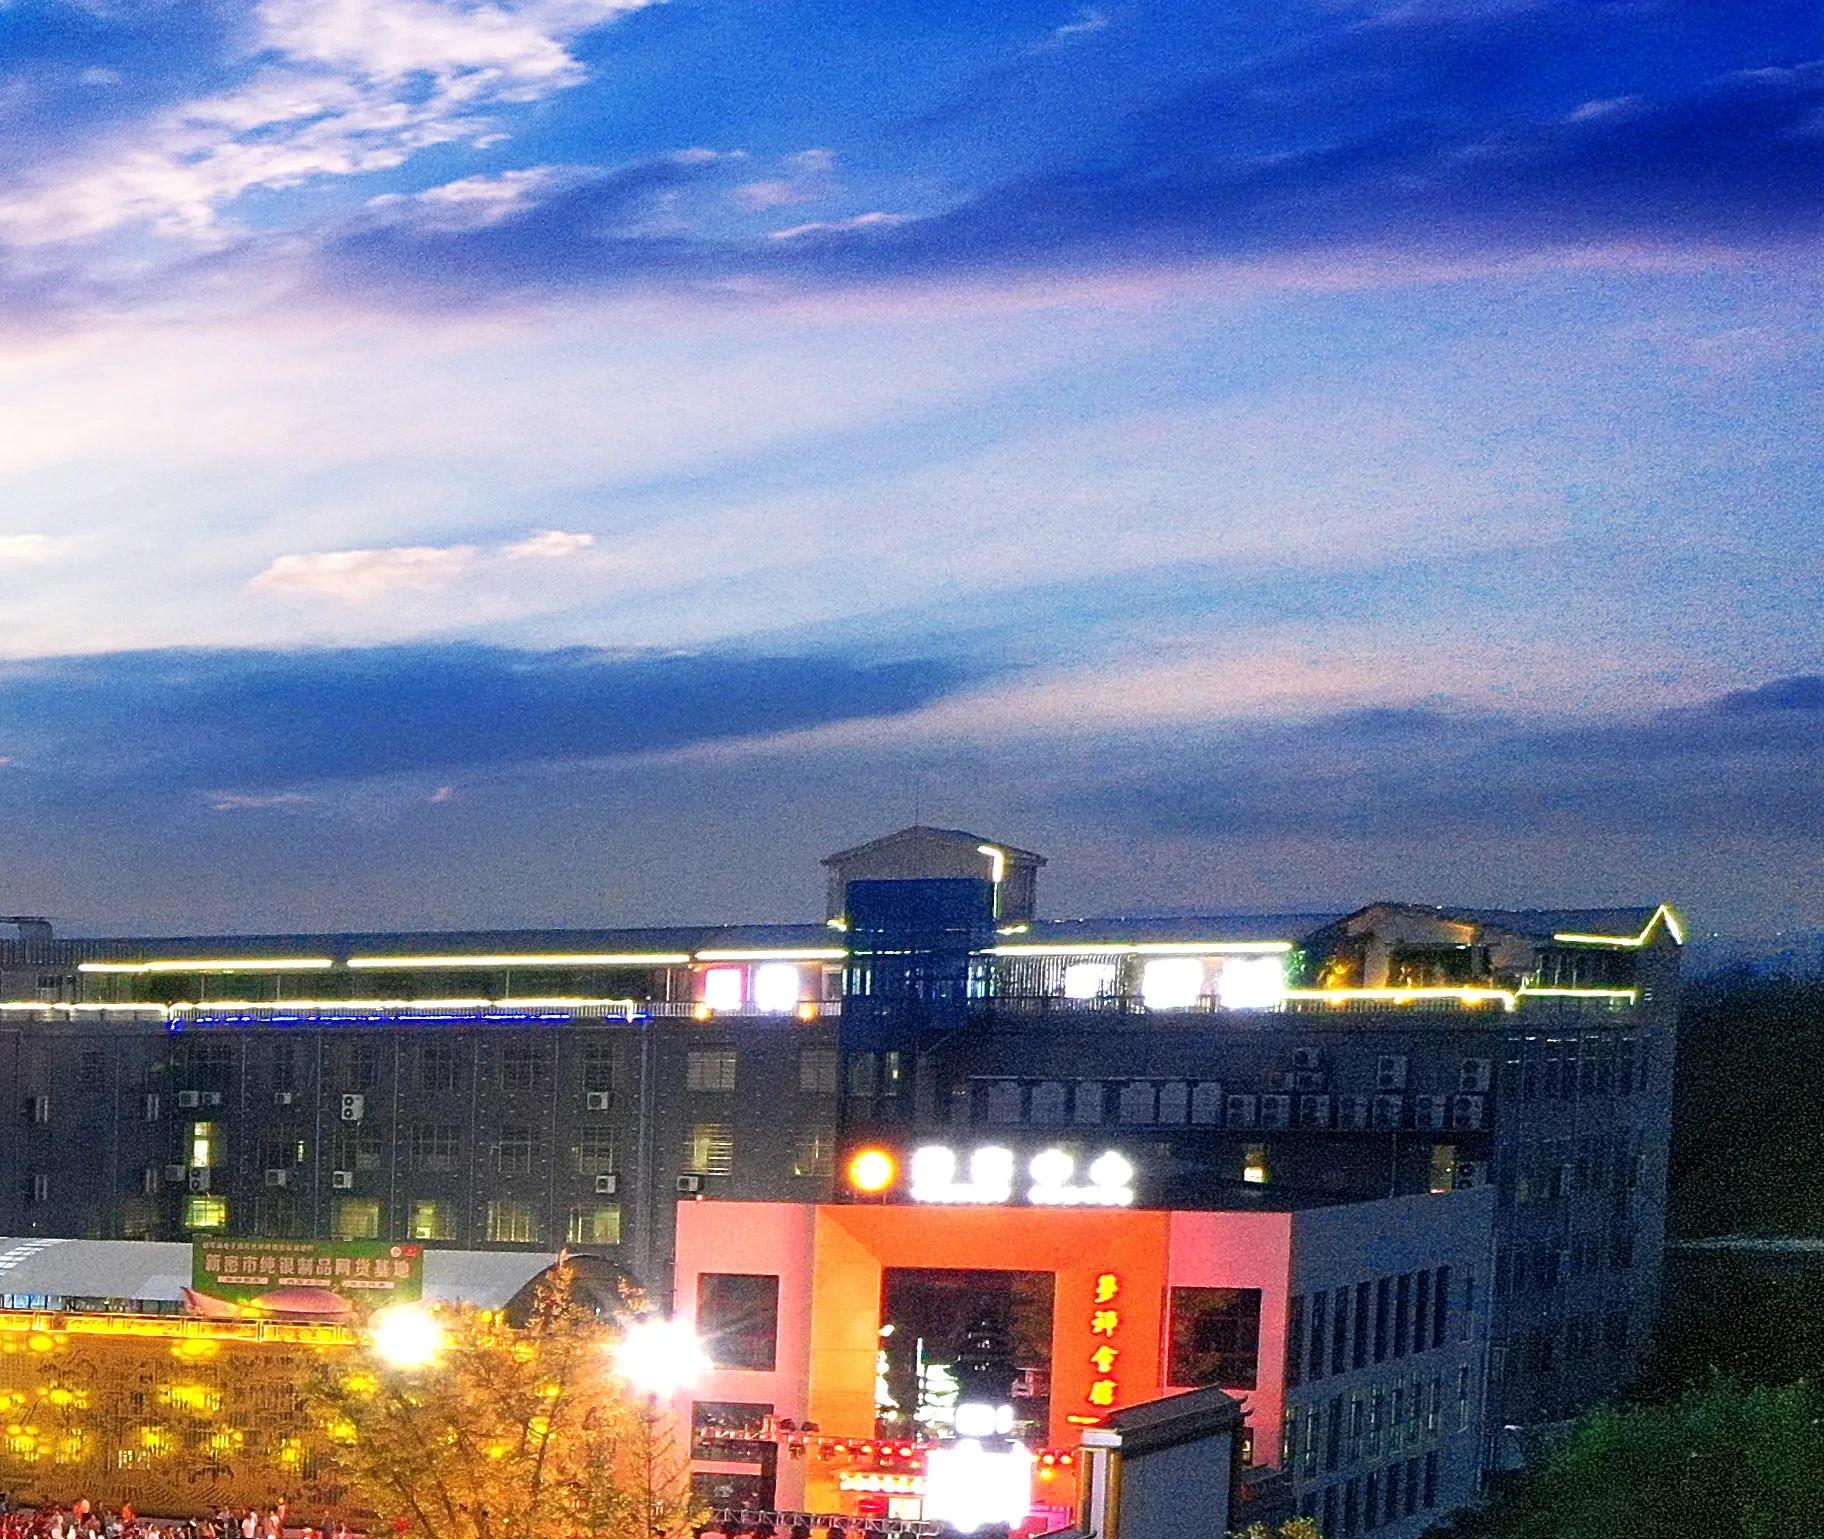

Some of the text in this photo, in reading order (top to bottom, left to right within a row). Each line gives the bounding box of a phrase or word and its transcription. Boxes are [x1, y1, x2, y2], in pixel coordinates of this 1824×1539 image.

[205, 1254, 410, 1278] 新密市纯银制品网货基地
